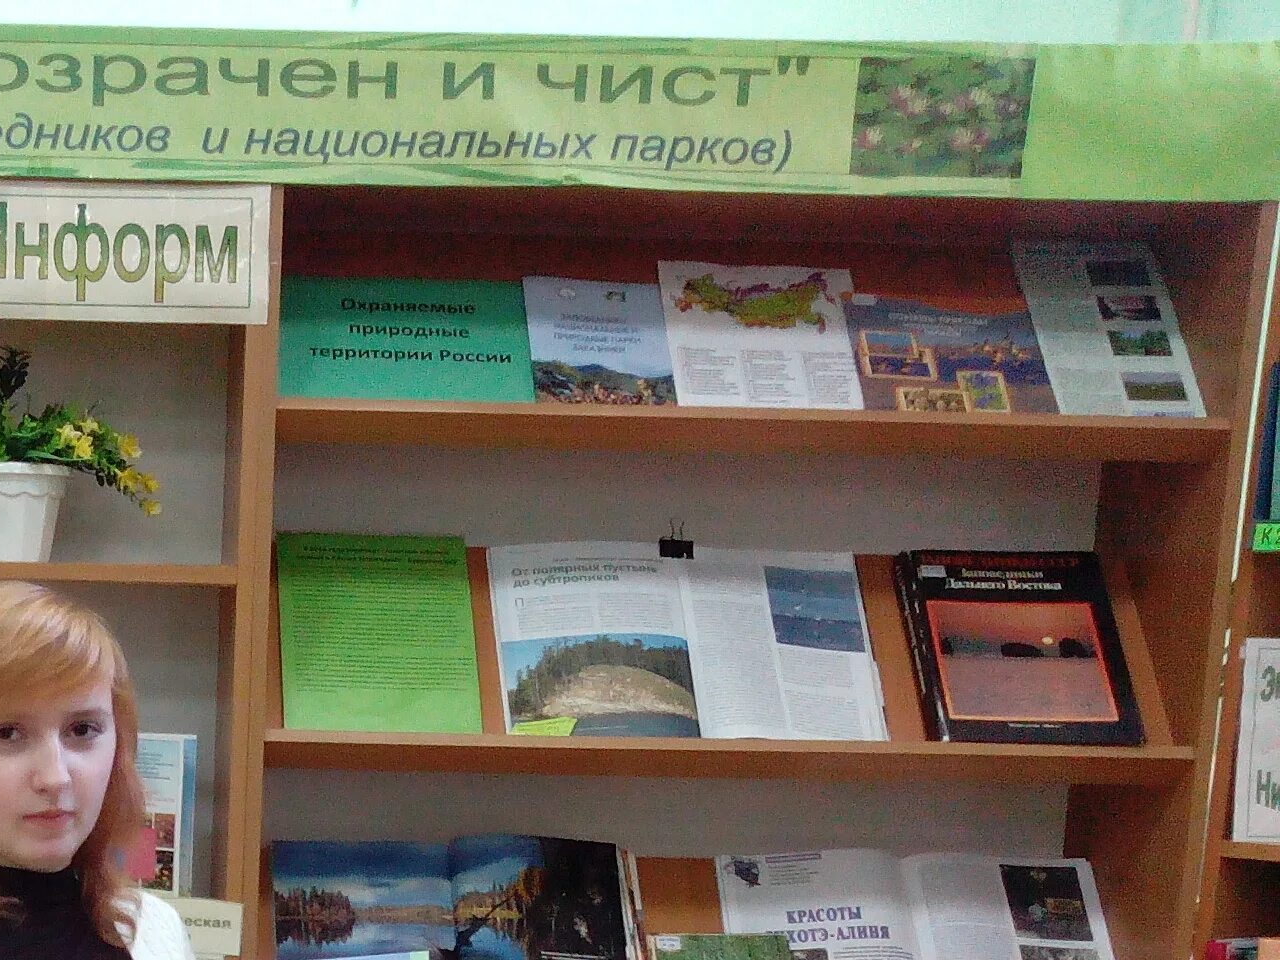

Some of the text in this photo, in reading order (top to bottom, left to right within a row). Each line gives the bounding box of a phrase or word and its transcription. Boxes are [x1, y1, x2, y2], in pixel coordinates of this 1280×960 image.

[443, 61, 495, 101] и
[537, 56, 810, 109] чист"
[201, 125, 226, 152] и
[244, 126, 595, 163] национальных
[609, 132, 792, 169] парков)
[340, 297, 477, 316] Охраняемые
[348, 322, 471, 342] природные
[309, 346, 513, 366] территории России
[511, 563, 658, 579] От полярных пустынь
[513, 573, 621, 589] до субтропиков
[1007, 579, 1063, 591] Востока
[786, 905, 863, 924] КРАСОТЫ
